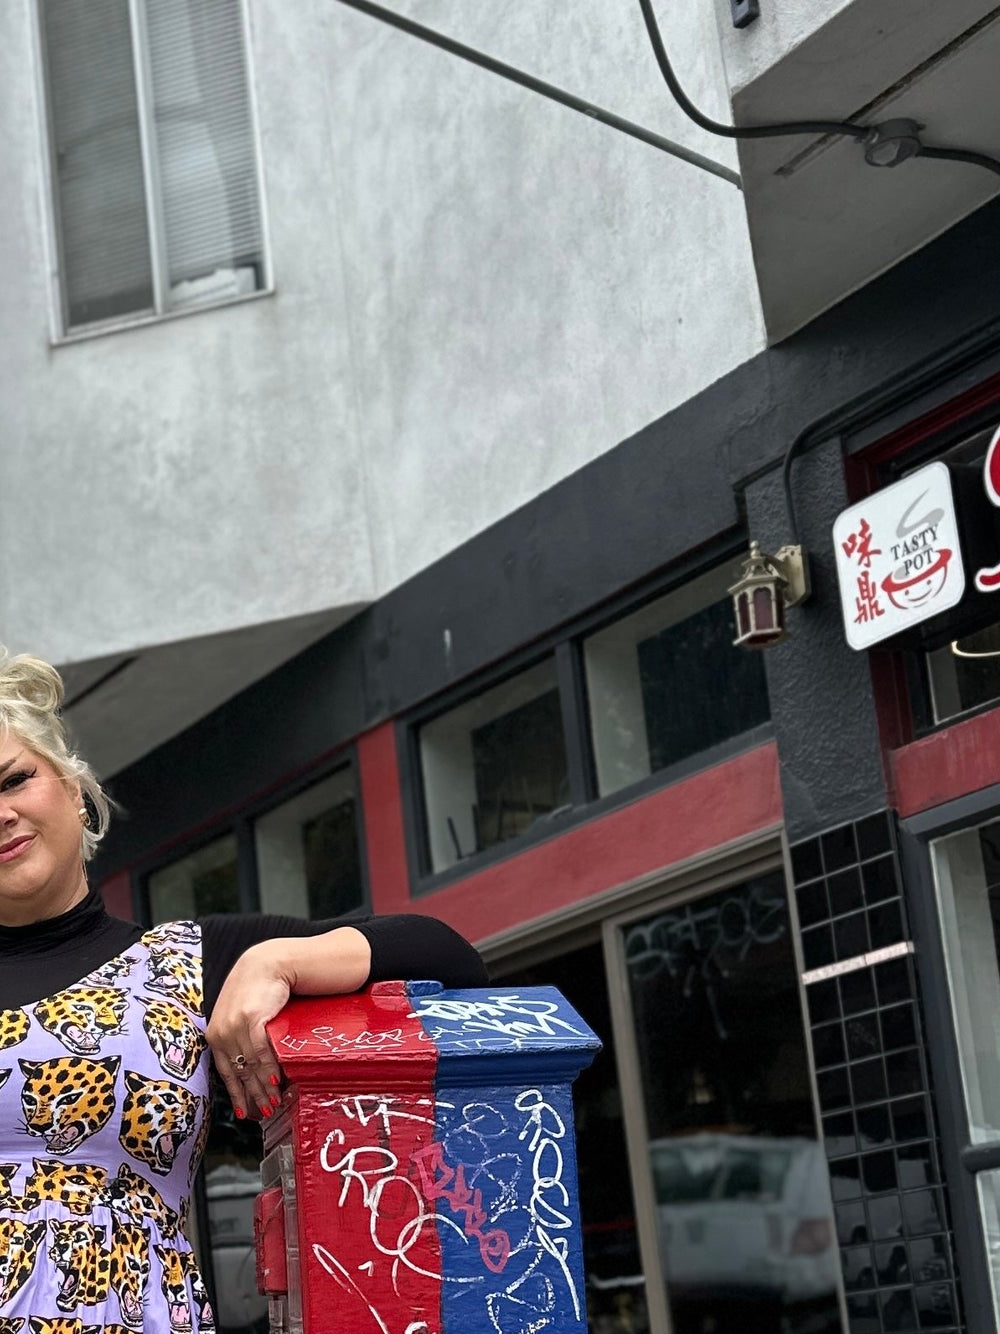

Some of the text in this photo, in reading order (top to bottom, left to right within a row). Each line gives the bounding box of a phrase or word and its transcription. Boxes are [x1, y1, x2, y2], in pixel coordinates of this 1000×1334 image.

[890, 523, 938, 561] TASTY
[842, 518, 885, 624] 味鼎
[903, 547, 934, 576] POT
